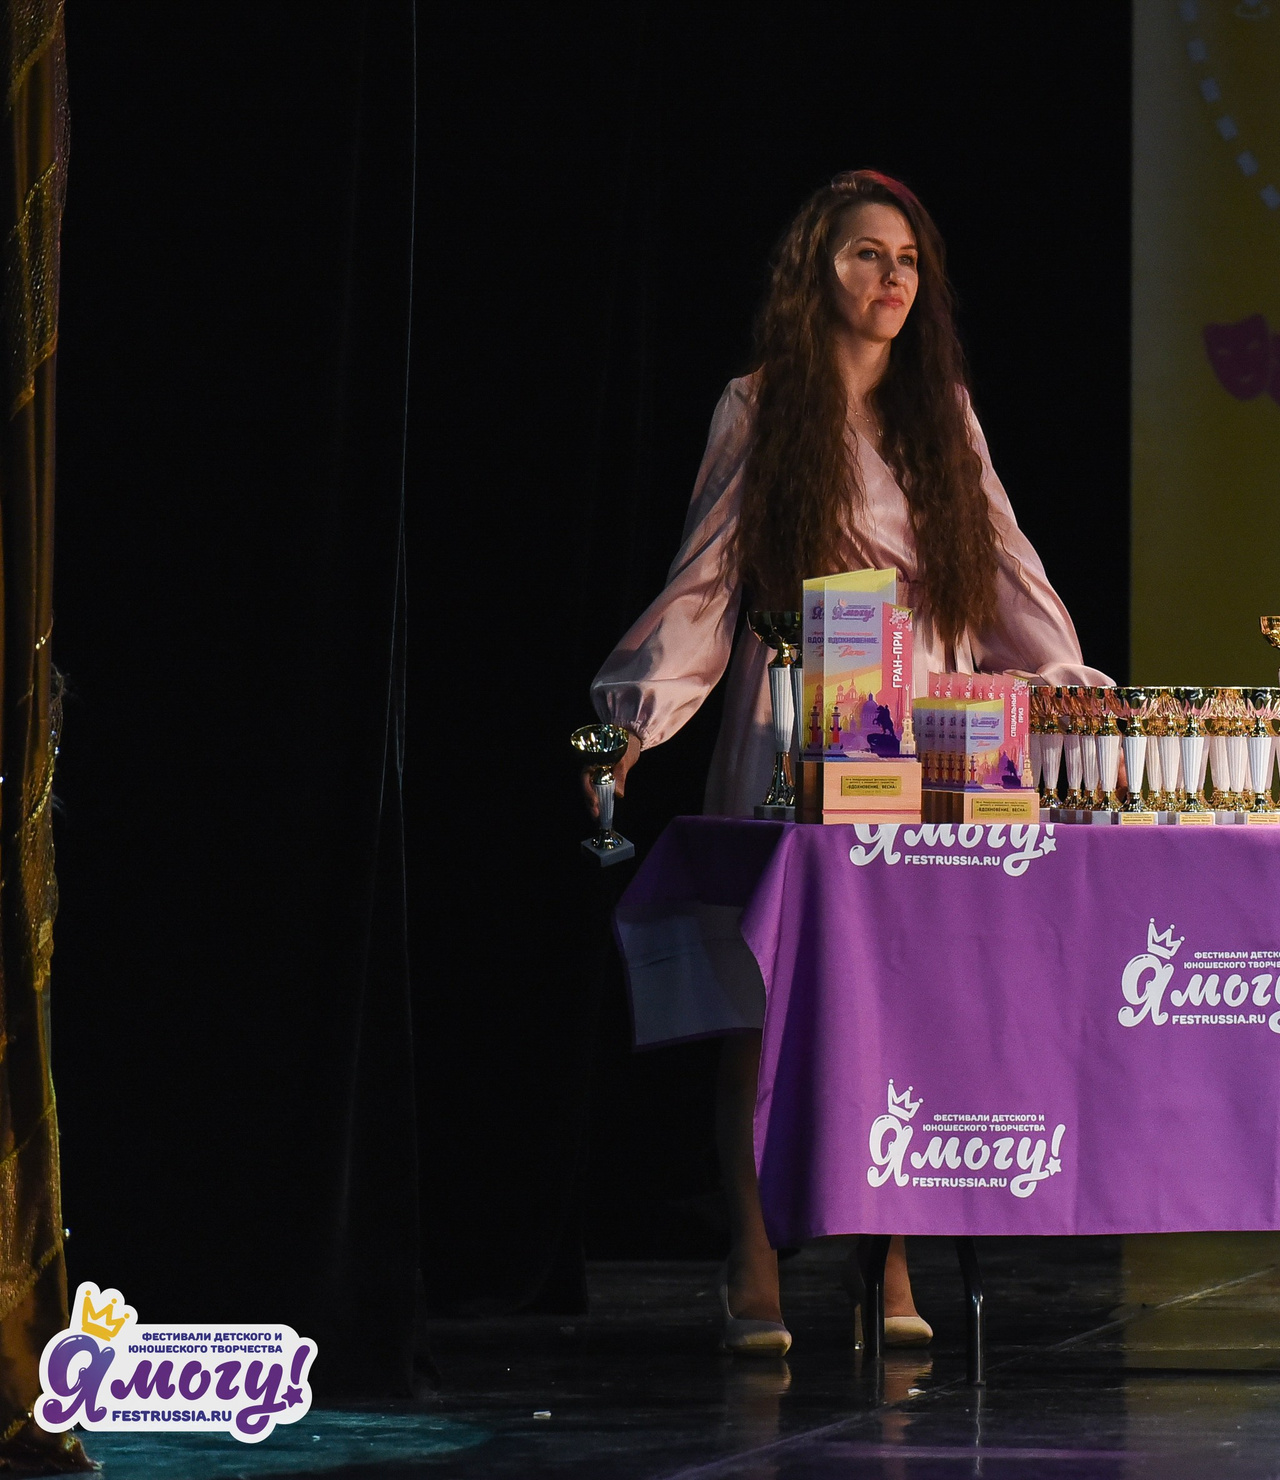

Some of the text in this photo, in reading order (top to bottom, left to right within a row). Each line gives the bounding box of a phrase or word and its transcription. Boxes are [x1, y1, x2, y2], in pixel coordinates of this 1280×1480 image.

[892, 631, 903, 688] ГРАН-ПРИ
[904, 855, 1001, 866] FESTRUSSIA.RU
[1194, 951, 1249, 959] ФЕСТИВАЛИ
[1183, 961, 1246, 969] ЮНОШЕСКОГО
[1118, 953, 1175, 1028] Я
[1172, 1014, 1266, 1025] FESTRUSSIA.RU
[933, 1113, 990, 1122] ФЕСТИВАЛИ
[992, 1114, 1036, 1123] ДЕТСКОГО
[922, 1124, 1046, 1132] ЮНОШЕСКОГО ТВОРЧЕСТВА
[867, 1114, 1066, 1199] Я могу!
[912, 1177, 1008, 1188] FESTRUSSIA.RU
